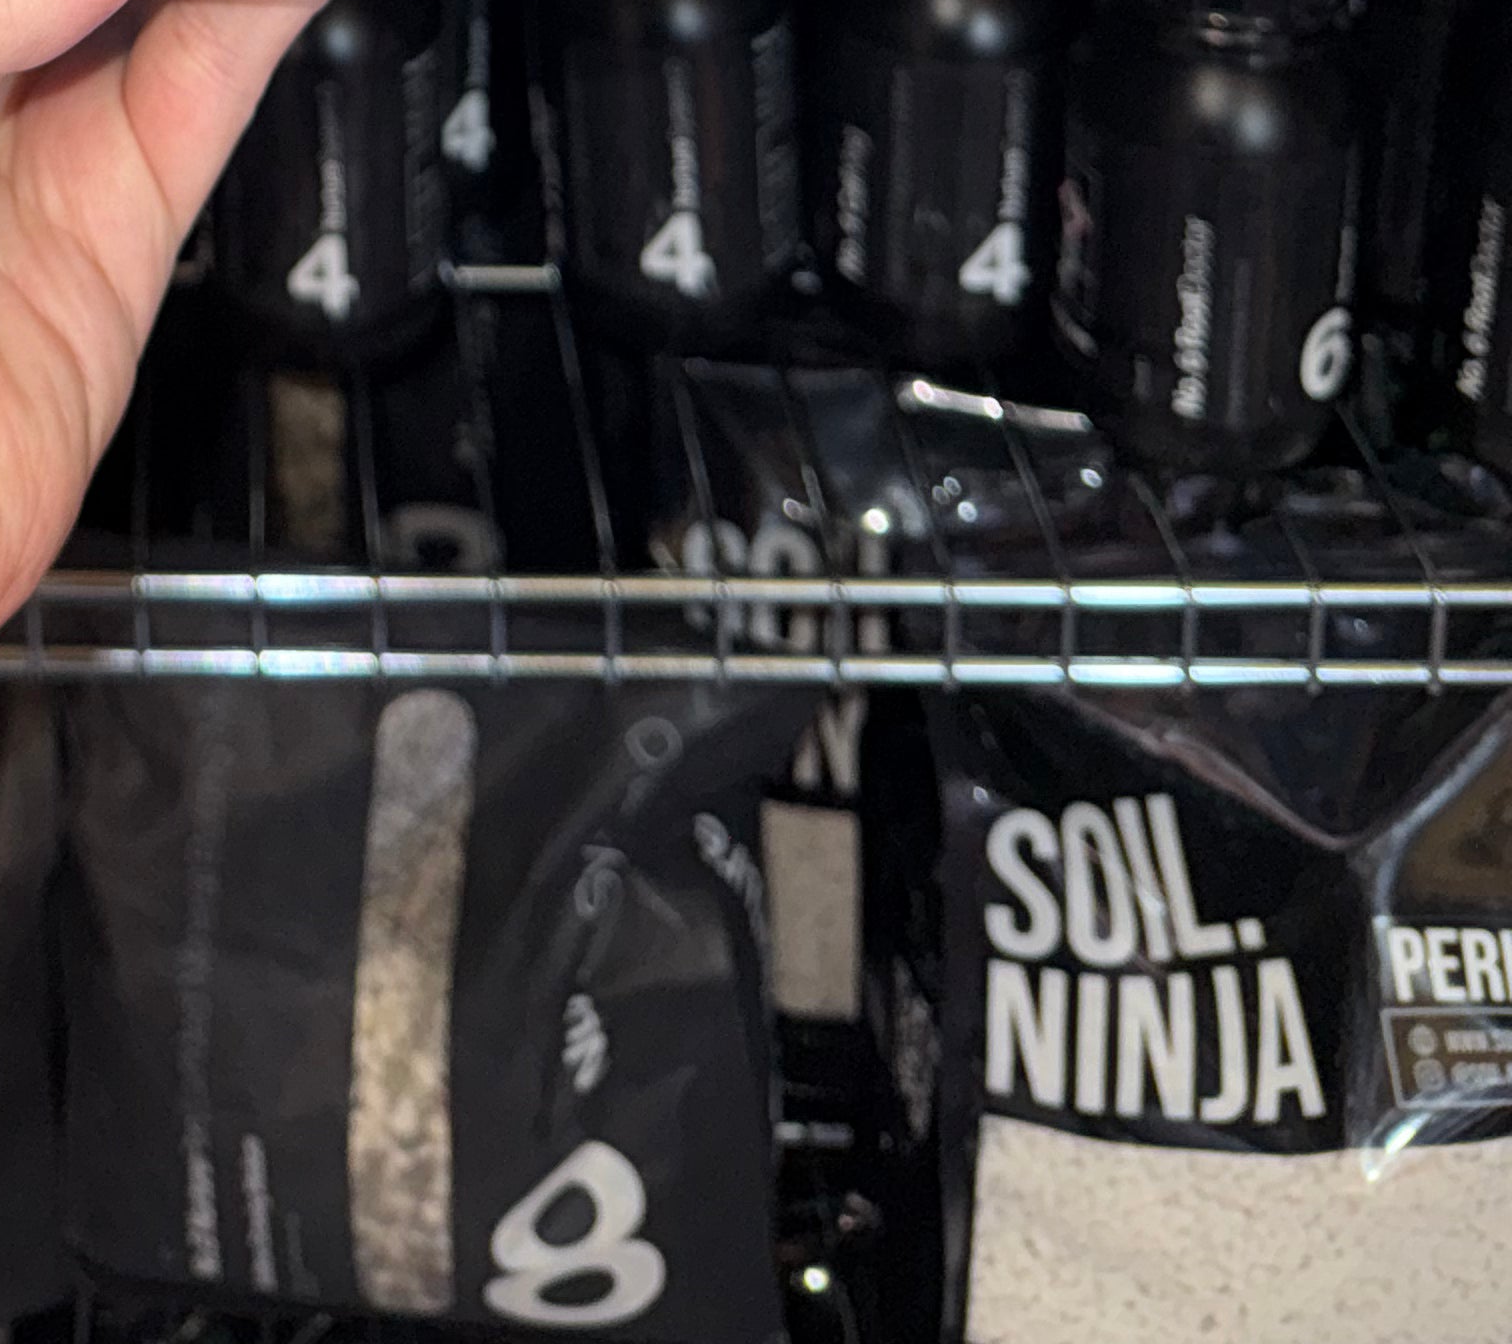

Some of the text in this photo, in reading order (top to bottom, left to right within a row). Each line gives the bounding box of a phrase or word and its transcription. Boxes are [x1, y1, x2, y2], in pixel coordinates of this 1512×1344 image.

[441, 87, 496, 171] 4
[288, 231, 361, 320] 4
[640, 211, 716, 298] 4
[959, 221, 1031, 305] 4
[1299, 307, 1352, 402] 6
[985, 793, 1266, 968] SOIL.
[1388, 926, 1511, 1003] PER
[985, 957, 1326, 1123] NINJA
[484, 1140, 666, 1328] 8
